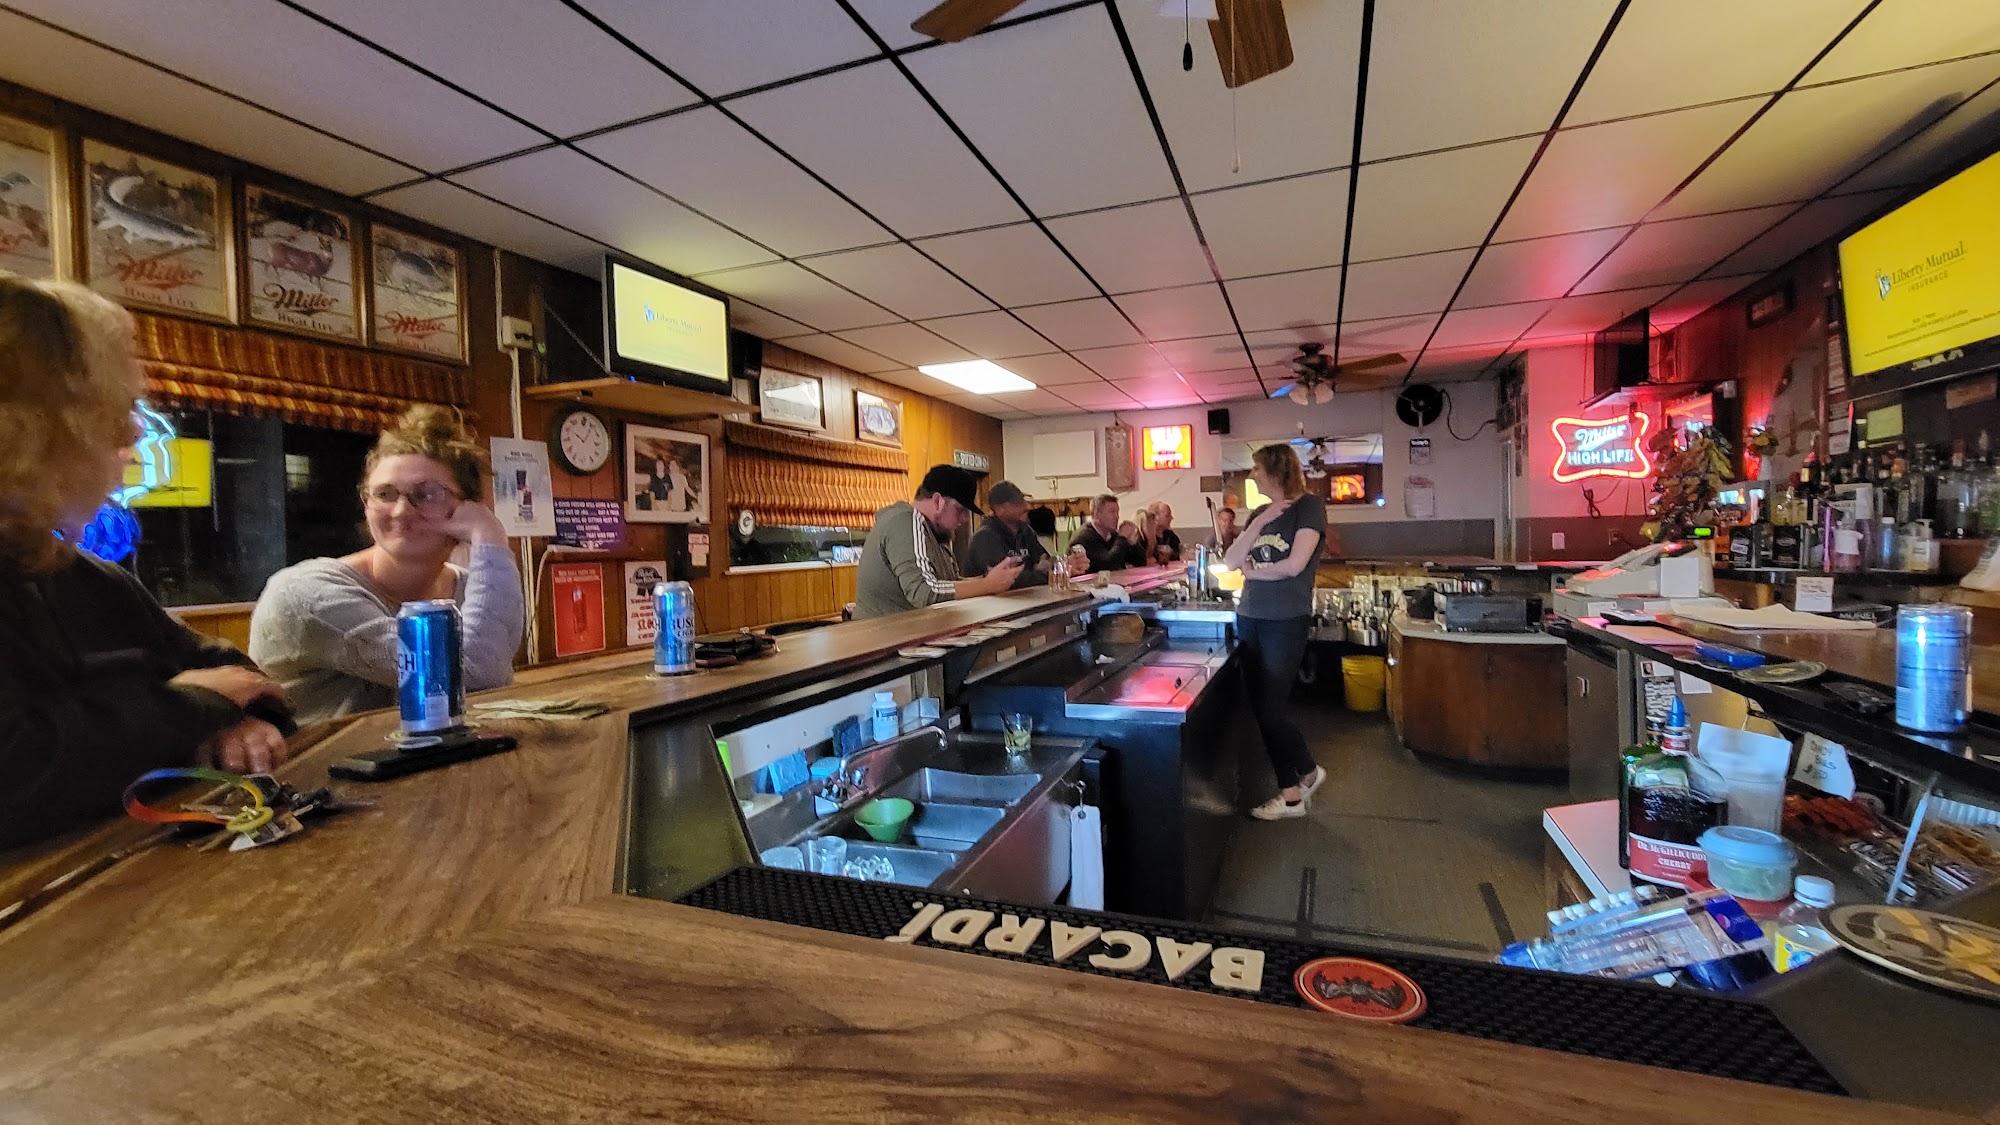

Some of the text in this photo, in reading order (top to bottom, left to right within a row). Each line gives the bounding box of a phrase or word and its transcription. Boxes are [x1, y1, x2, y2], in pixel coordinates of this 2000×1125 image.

[1891, 241, 1963, 285] Liberty Mutual
[1908, 270, 1949, 292] INSURANCE
[263, 282, 338, 313] Miller
[384, 310, 446, 337] Miller
[1574, 423, 1627, 451] Miller
[1567, 449, 1634, 465] HIGH LIFE
[1657, 857, 1692, 870] CHERRY
